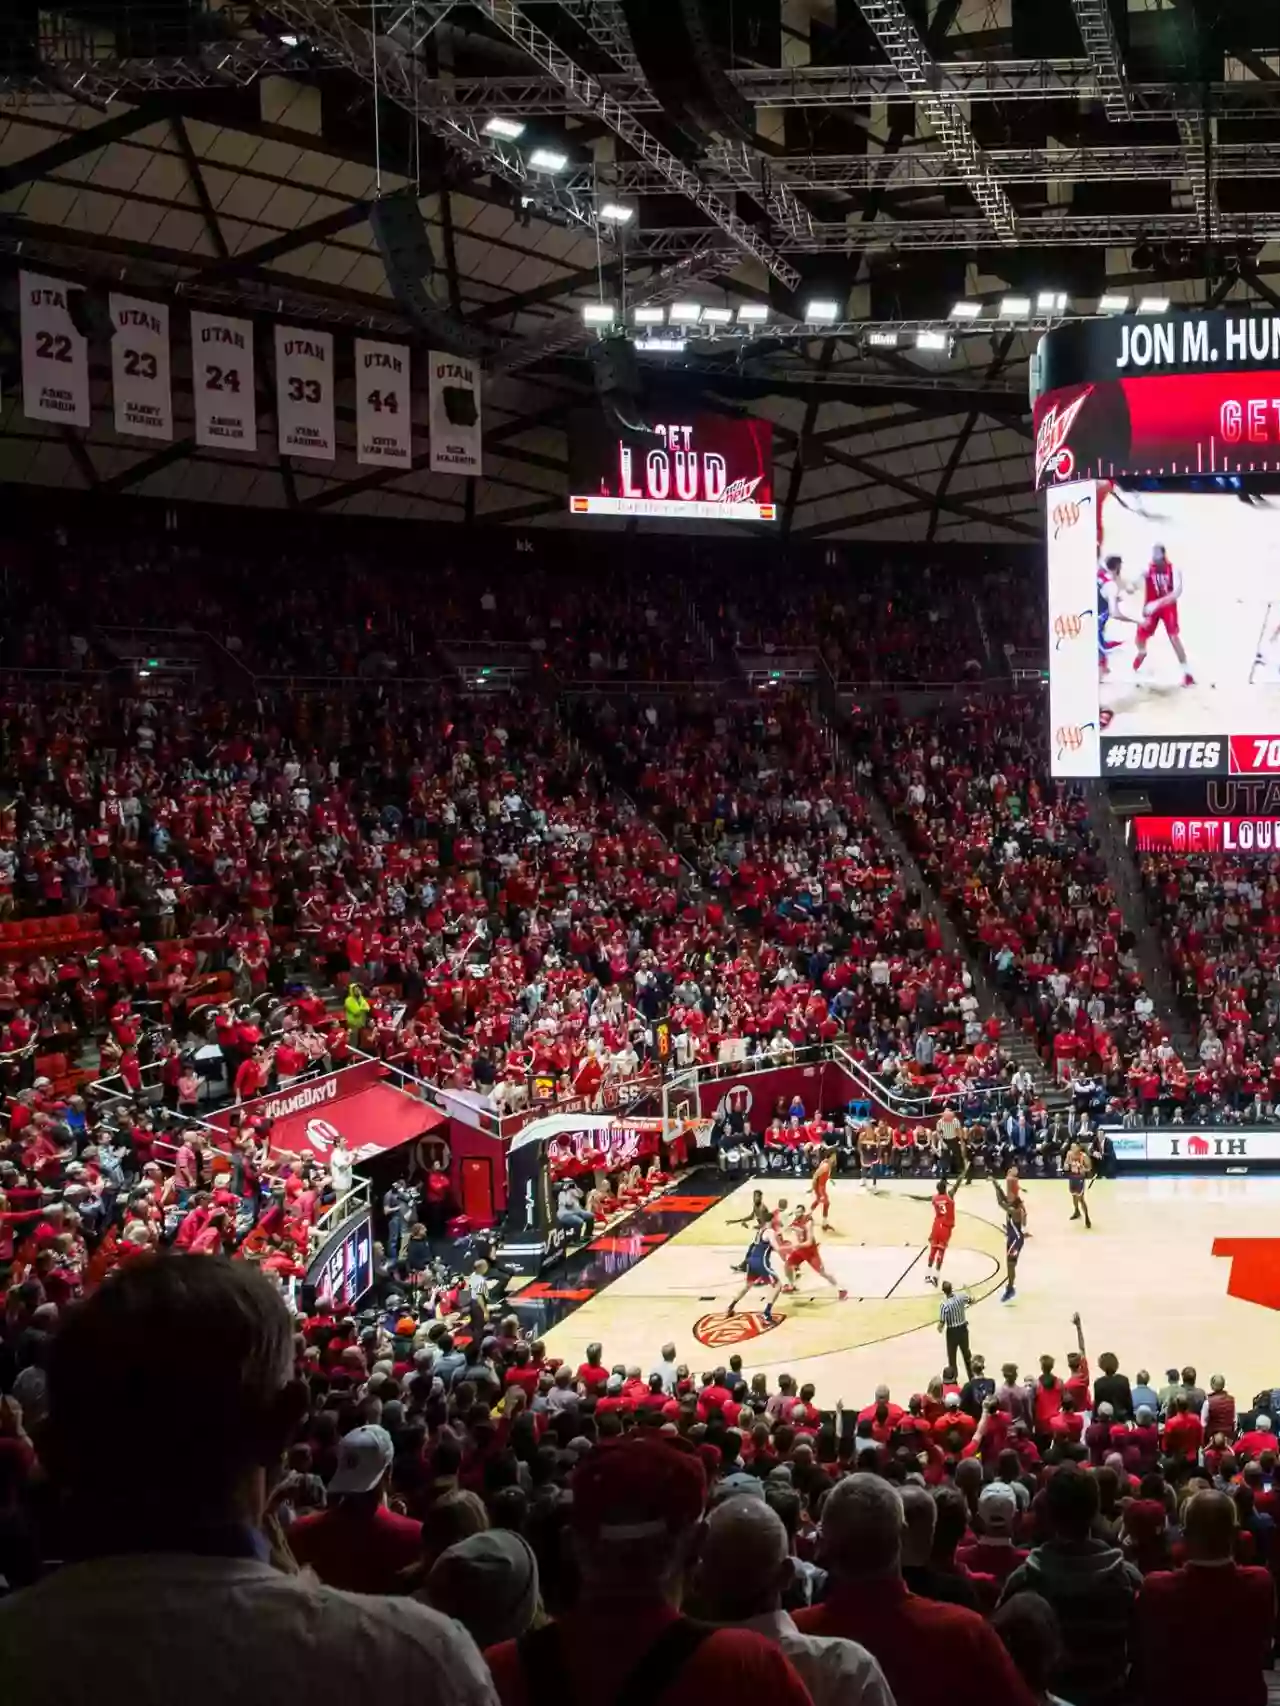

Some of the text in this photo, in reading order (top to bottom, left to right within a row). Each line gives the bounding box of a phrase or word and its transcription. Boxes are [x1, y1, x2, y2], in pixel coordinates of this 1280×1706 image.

[31, 290, 67, 309] UTA
[119, 310, 162, 336] UTAH
[36, 331, 73, 362] 22
[202, 327, 244, 350] UTAH
[284, 340, 325, 362] UTAH
[1115, 323, 1174, 368] JON
[1182, 320, 1219, 365] M.
[124, 349, 157, 380] 23
[364, 354, 403, 374] UTAH
[436, 364, 474, 383] UTAH
[205, 365, 240, 393] 24
[288, 377, 321, 403] 33
[368, 390, 398, 413] 44
[620, 446, 727, 500] LOUD
[1106, 742, 1221, 769] #GOUTES
[1171, 820, 1219, 849] GET
[1170, 1139, 1247, 1155] I IH
